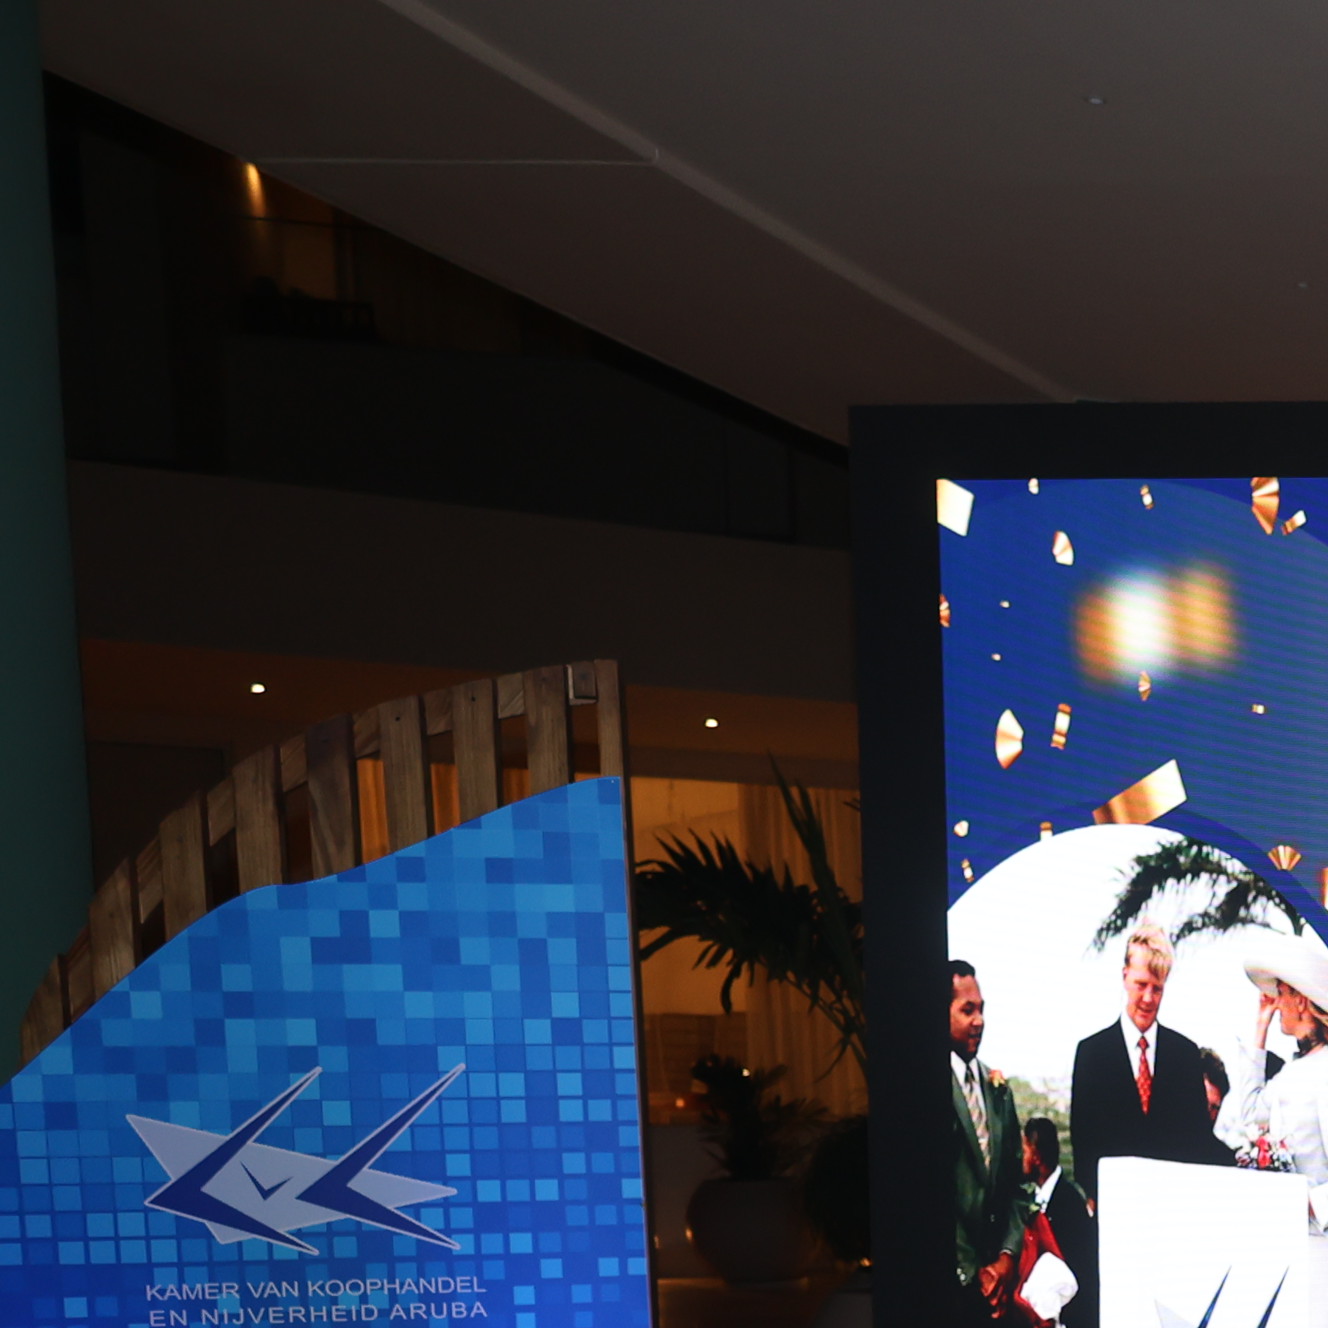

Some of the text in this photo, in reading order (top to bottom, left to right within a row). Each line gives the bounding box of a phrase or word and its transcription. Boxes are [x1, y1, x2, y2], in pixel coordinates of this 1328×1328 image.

[146, 1276, 488, 1301] KAMER VAN KOOPHANDEL
[149, 1302, 488, 1327] EN NIJVERHEID ARUBA
